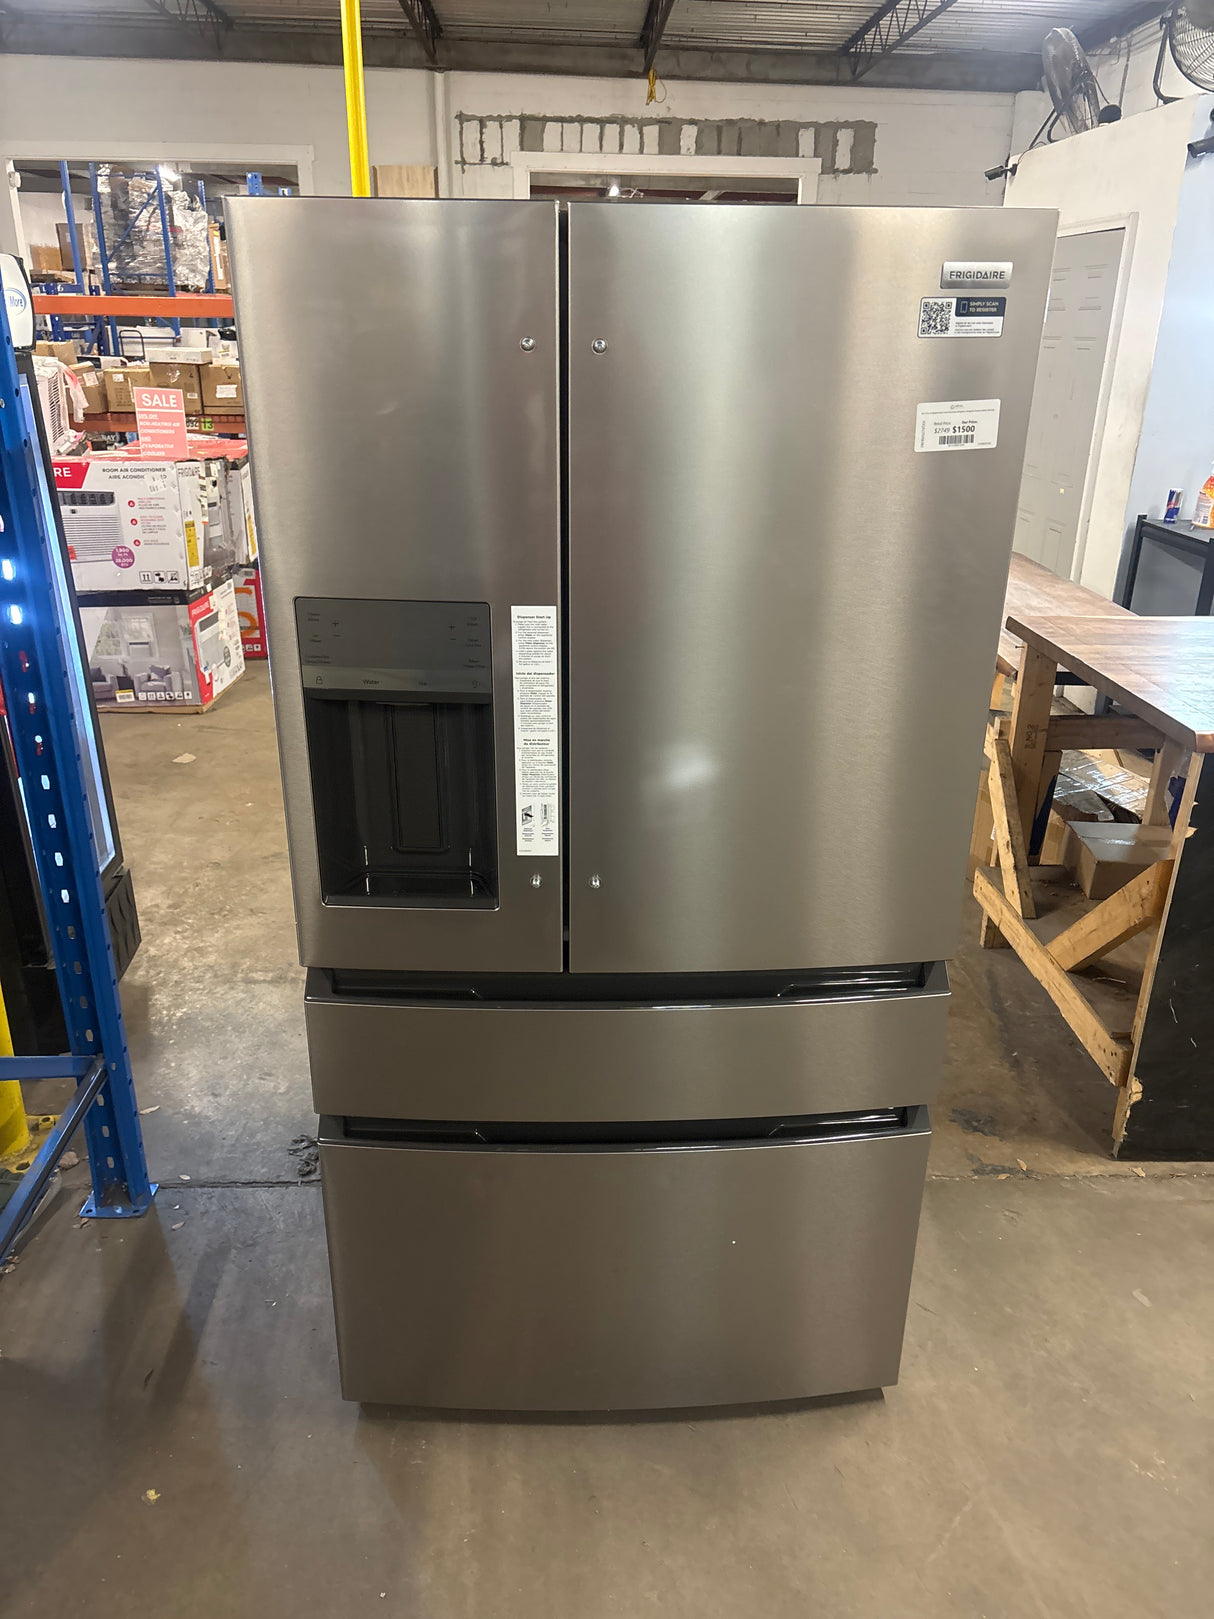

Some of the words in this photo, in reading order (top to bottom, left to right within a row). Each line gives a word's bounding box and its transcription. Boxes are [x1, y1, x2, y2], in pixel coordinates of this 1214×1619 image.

[949, 270, 1006, 280] FRIGIDAIRE
[141, 393, 177, 407] SALE
[952, 425, 976, 433] $1500
